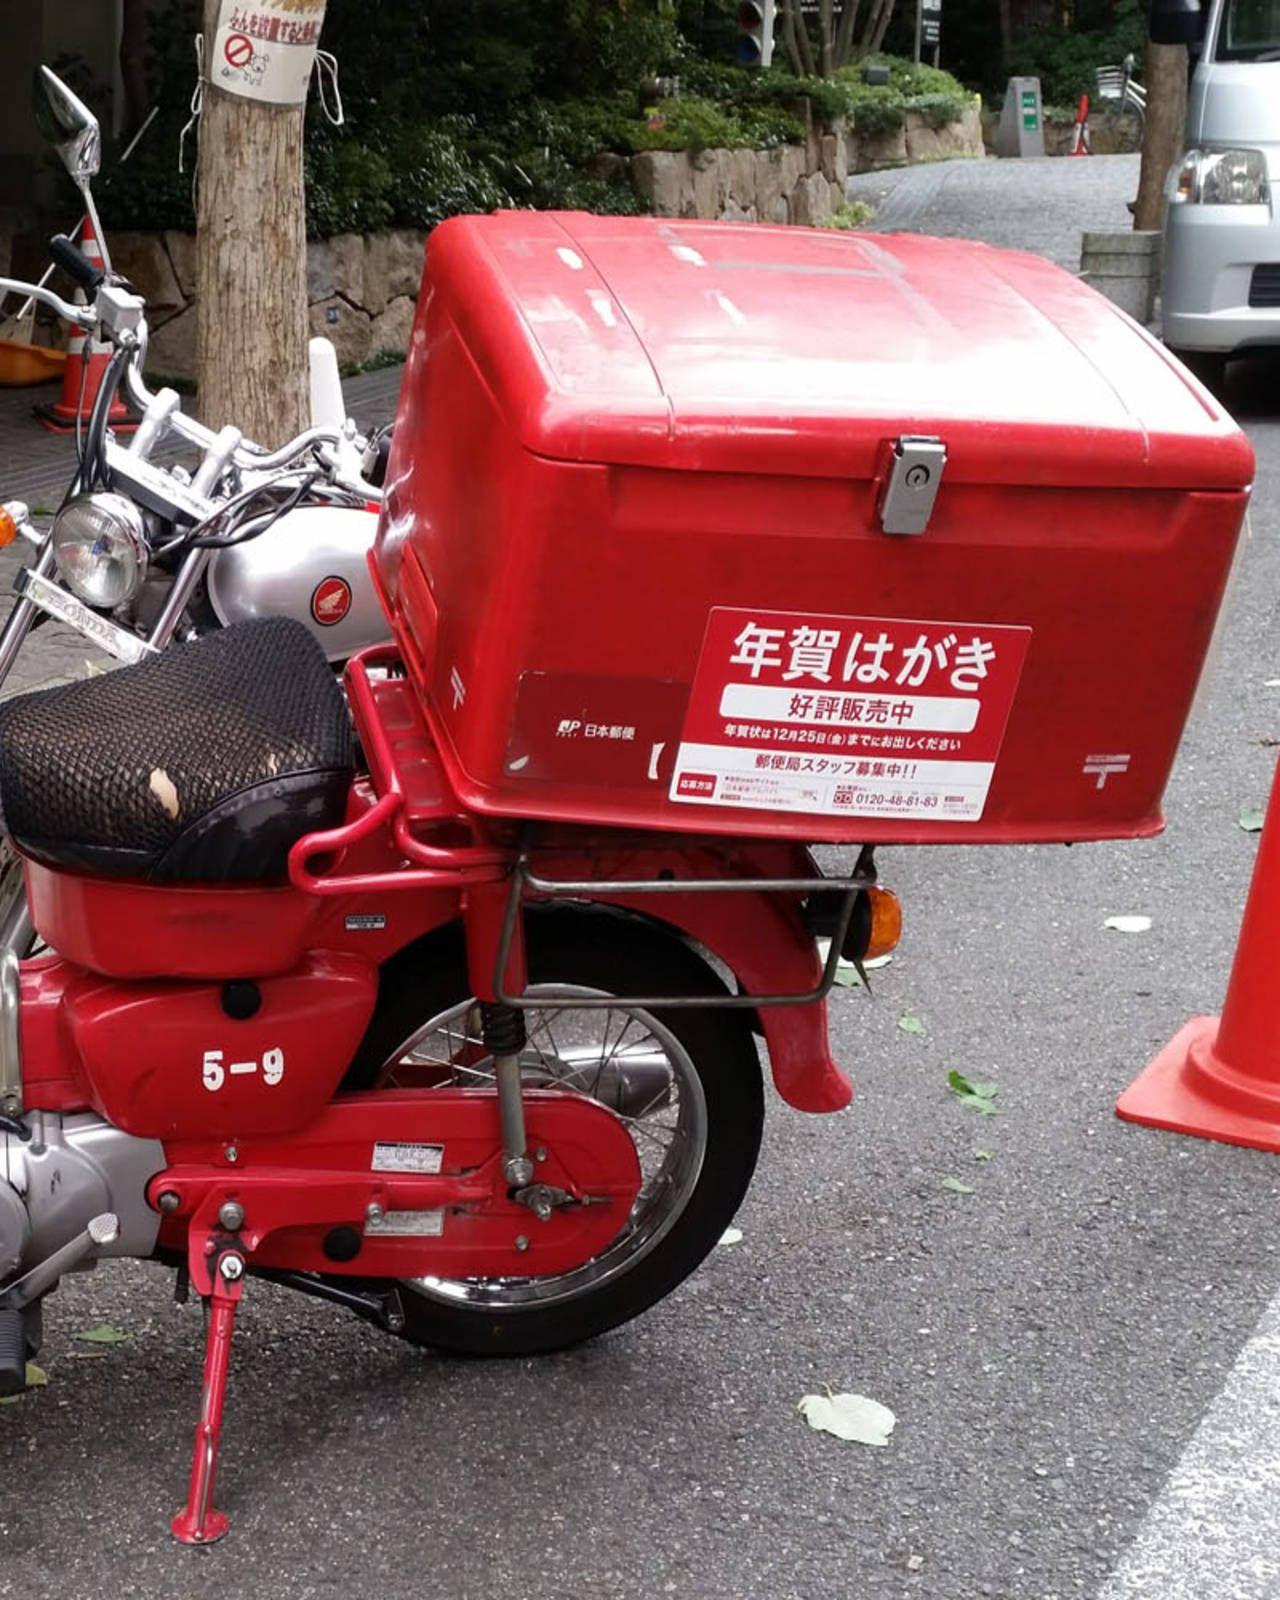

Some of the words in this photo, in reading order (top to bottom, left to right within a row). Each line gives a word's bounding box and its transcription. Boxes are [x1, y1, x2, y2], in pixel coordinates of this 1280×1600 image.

[729, 621, 997, 691] 年賀はがき
[787, 693, 915, 726] 好評販売中
[584, 724, 636, 740] 日本郵便
